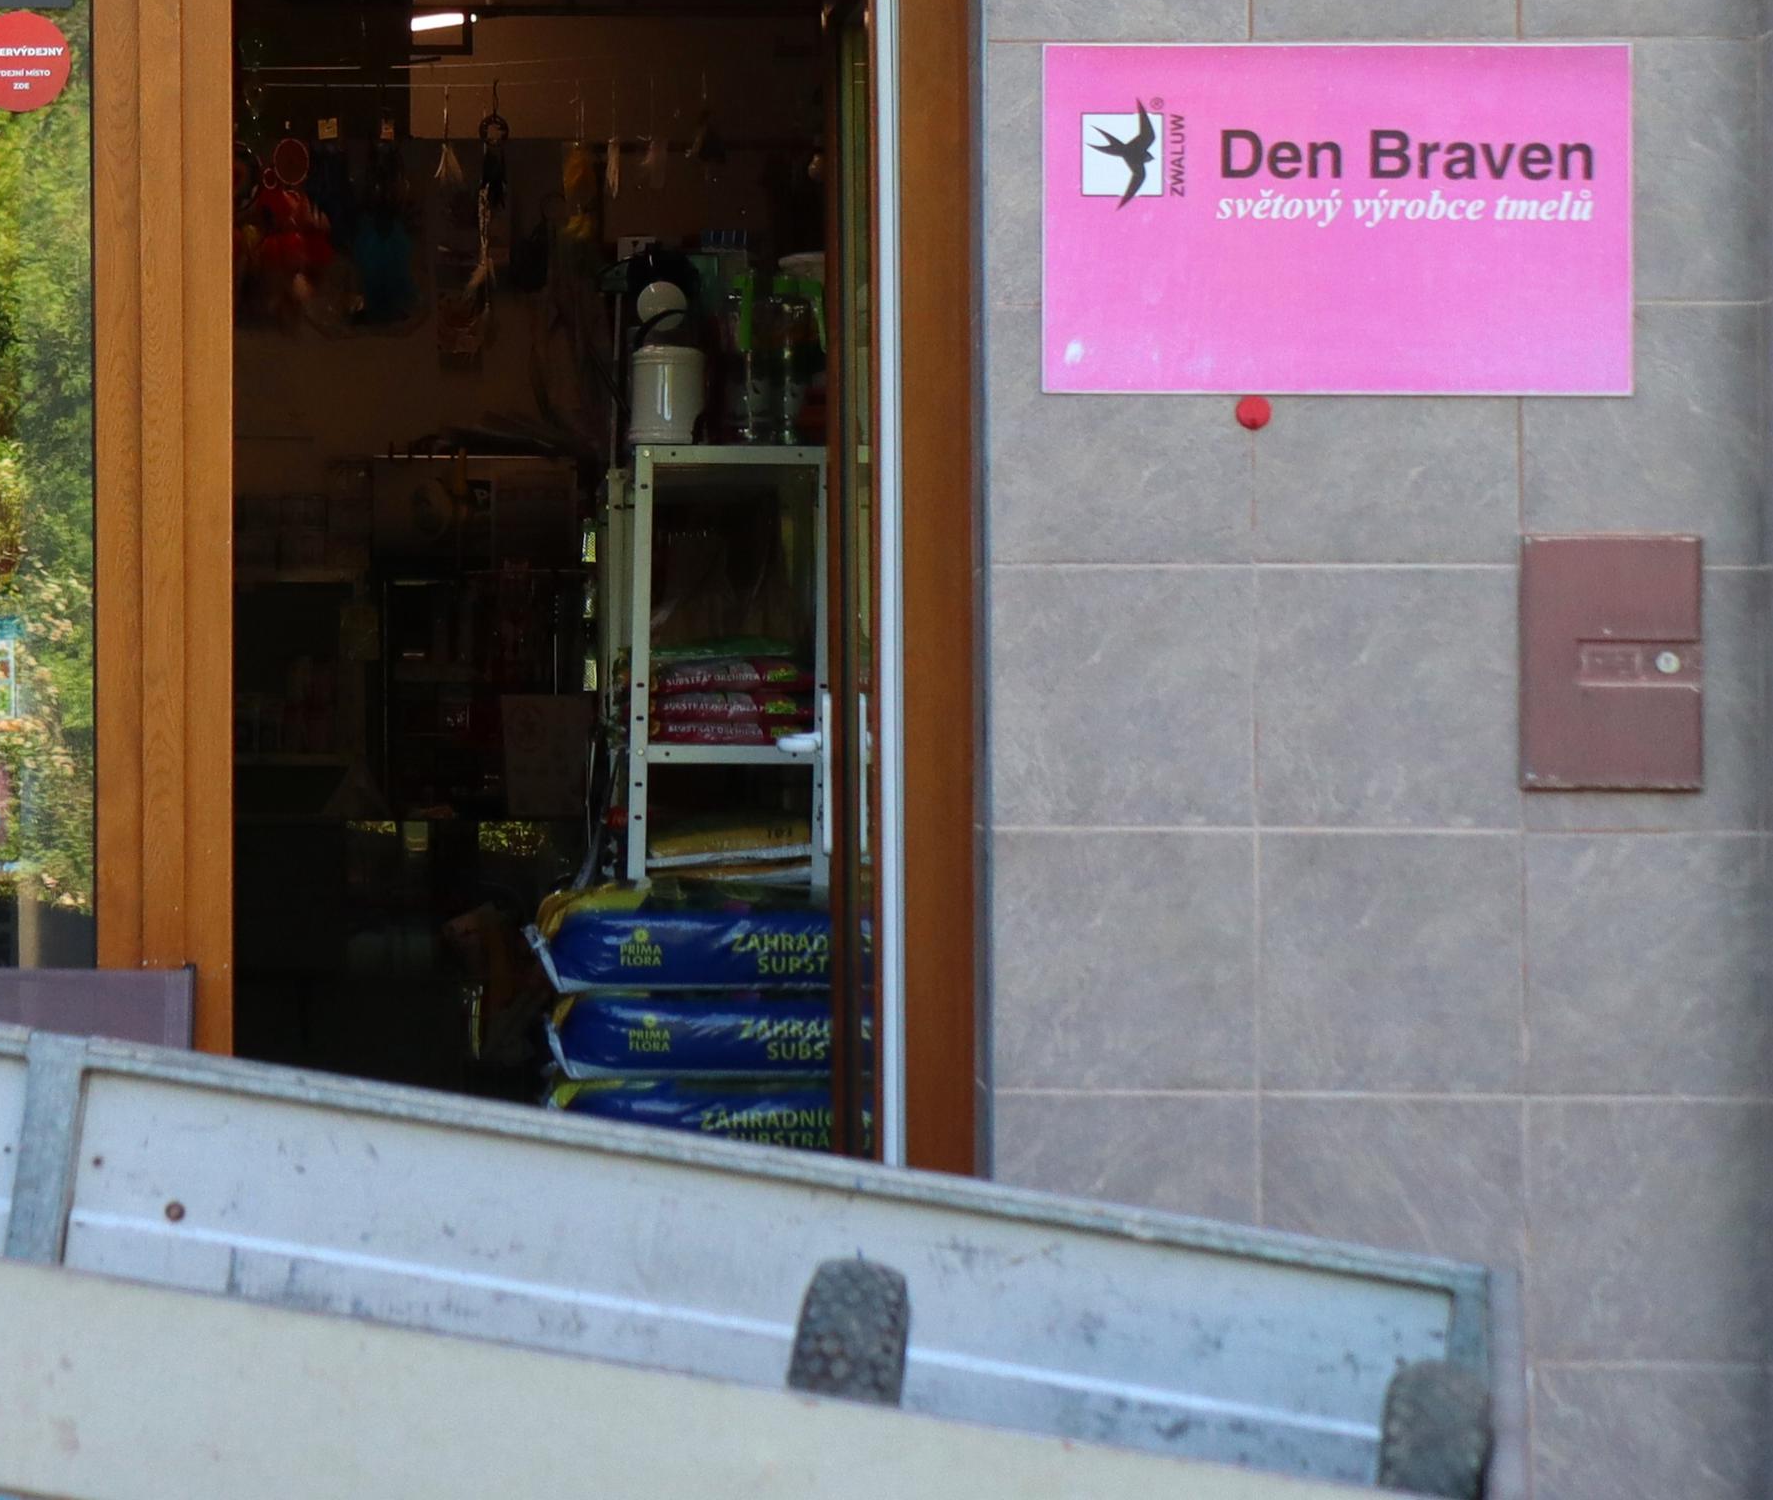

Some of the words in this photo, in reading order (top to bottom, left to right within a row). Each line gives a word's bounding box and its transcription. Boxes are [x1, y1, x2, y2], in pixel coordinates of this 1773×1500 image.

[12, 82, 30, 90] ZDE
[1170, 113, 1185, 197] ZWALUW
[1220, 128, 1343, 180] Den
[1370, 128, 1595, 181] Braven
[1216, 189, 1343, 228] světový
[1353, 190, 1483, 228] výrobce
[1494, 188, 1595, 222] tmelů
[620, 944, 662, 956] PRIMA
[620, 955, 662, 967] FLORA
[629, 1029, 671, 1041] PRIMA
[629, 1040, 671, 1052] FLORA
